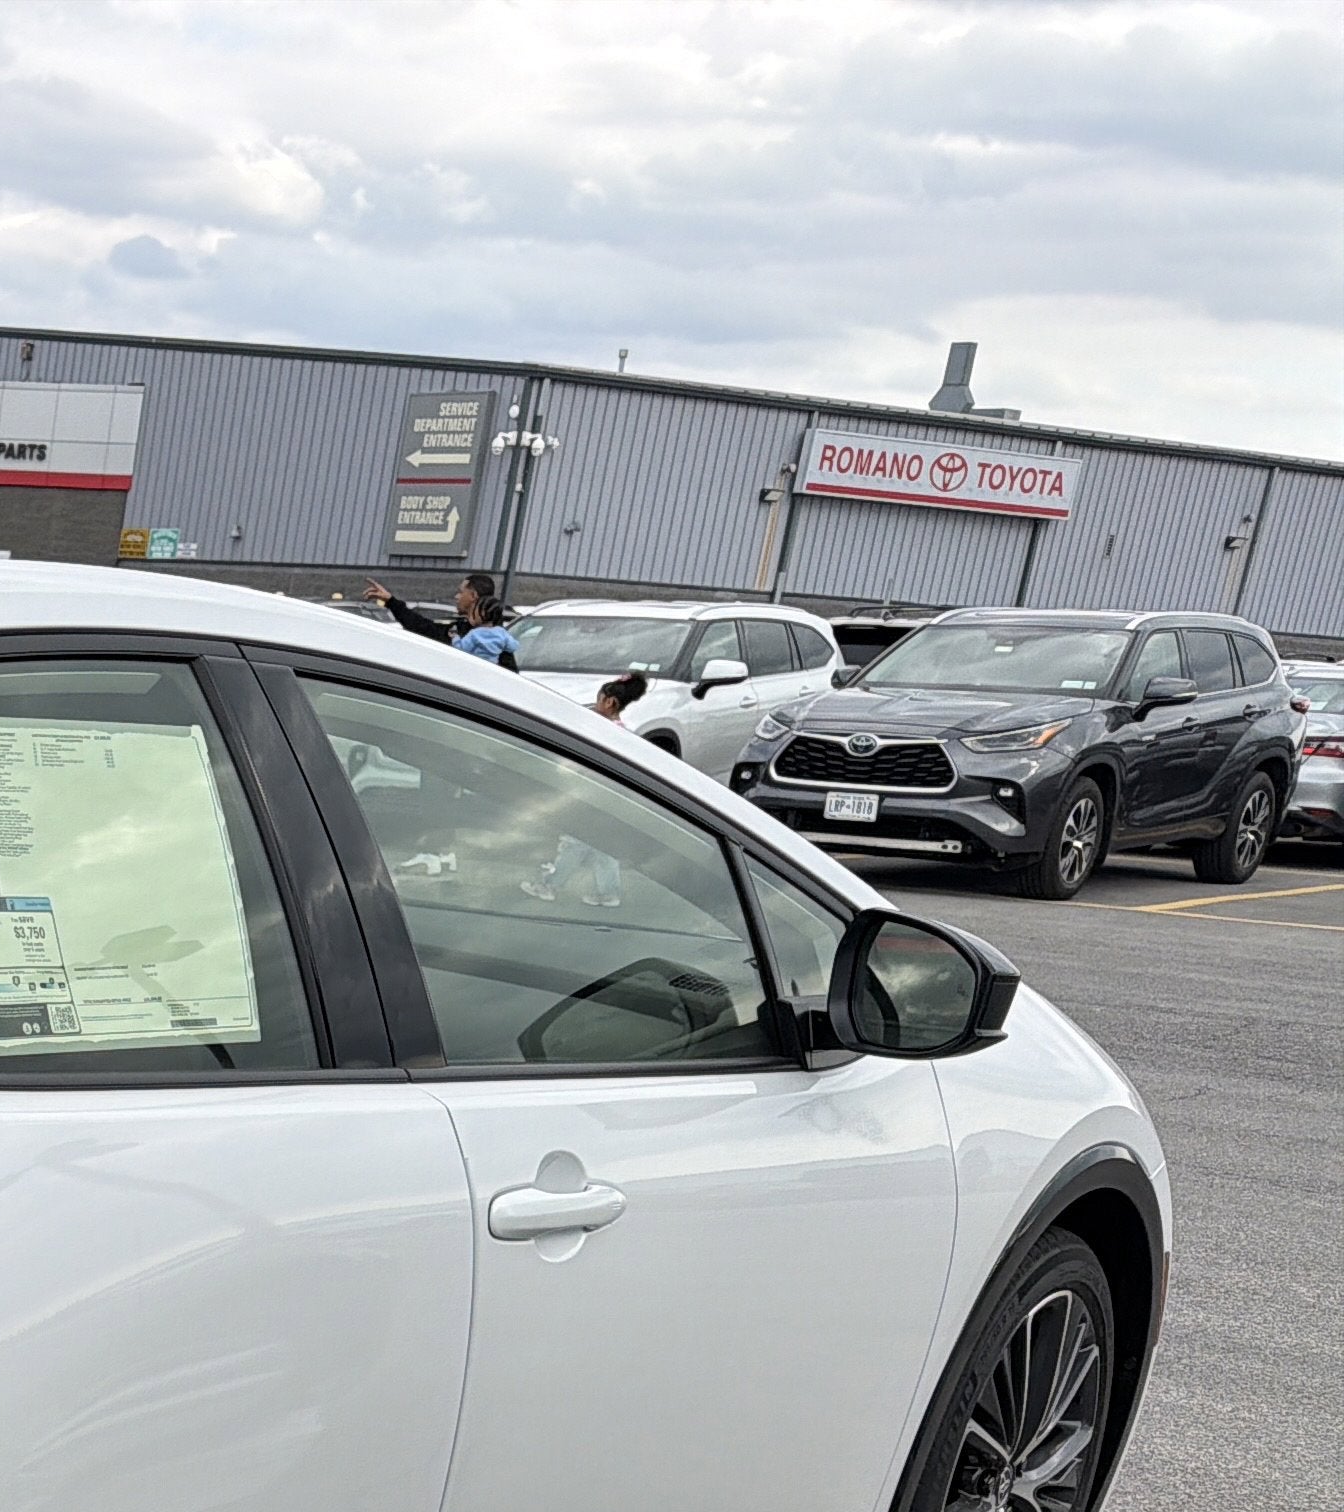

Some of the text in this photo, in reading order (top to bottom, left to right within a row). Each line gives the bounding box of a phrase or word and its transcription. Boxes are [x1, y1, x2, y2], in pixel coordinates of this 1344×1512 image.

[439, 402, 480, 416] SERVICE
[413, 418, 478, 432] DEPARTMENT
[423, 434, 474, 447] ENTRANCE
[818, 443, 1064, 498] ROMANO TOYOTA
[399, 496, 451, 509] BODY SHOP
[397, 511, 446, 525] ENTRANCE
[13, 926, 46, 941] $3,750
